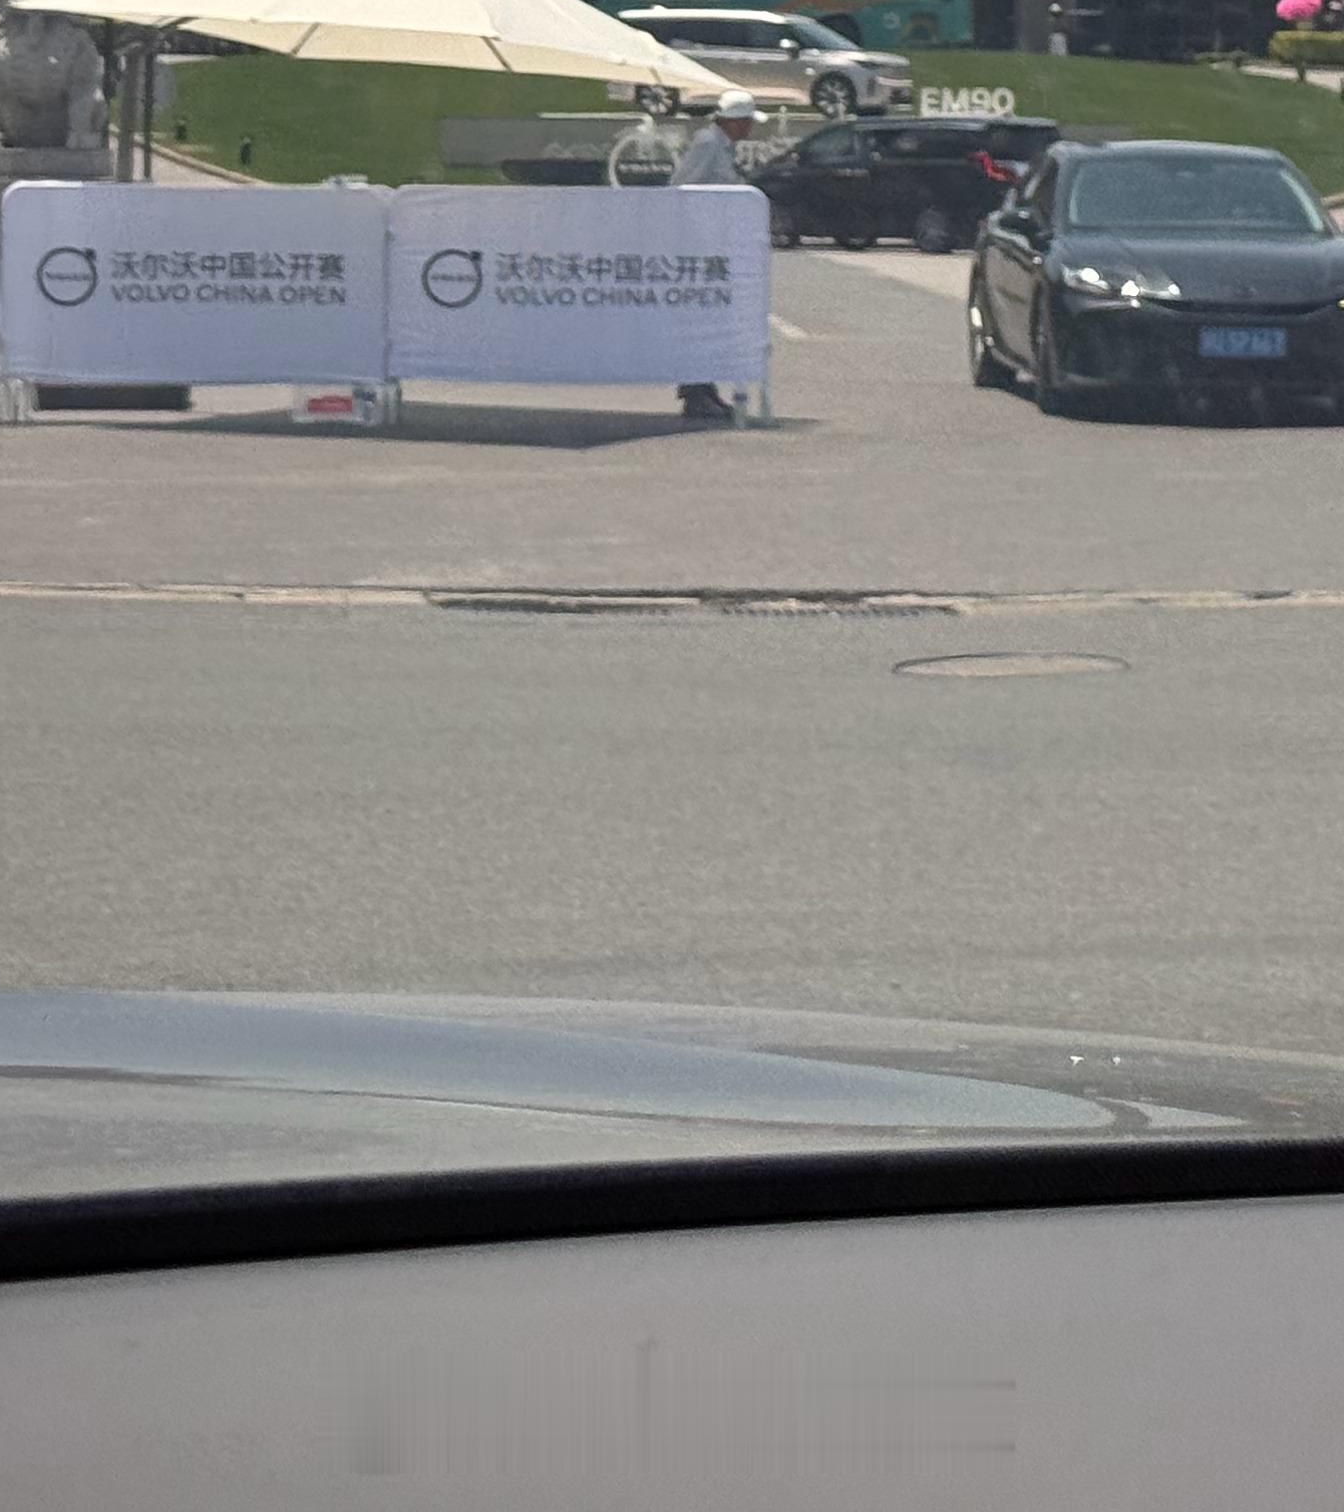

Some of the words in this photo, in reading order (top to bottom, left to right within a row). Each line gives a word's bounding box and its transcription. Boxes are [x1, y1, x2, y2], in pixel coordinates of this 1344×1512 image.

[920, 86, 1015, 118] EM90
[111, 250, 346, 281] 沃尔沃中国公开赛
[496, 252, 730, 282] 沃尔沃中国公开赛
[110, 284, 191, 304] VOLVO
[196, 284, 274, 305] CHINA
[279, 285, 347, 306] OPEN
[496, 285, 577, 307] VOLVO
[582, 286, 658, 307] CHINA
[665, 287, 733, 307] OPEN
